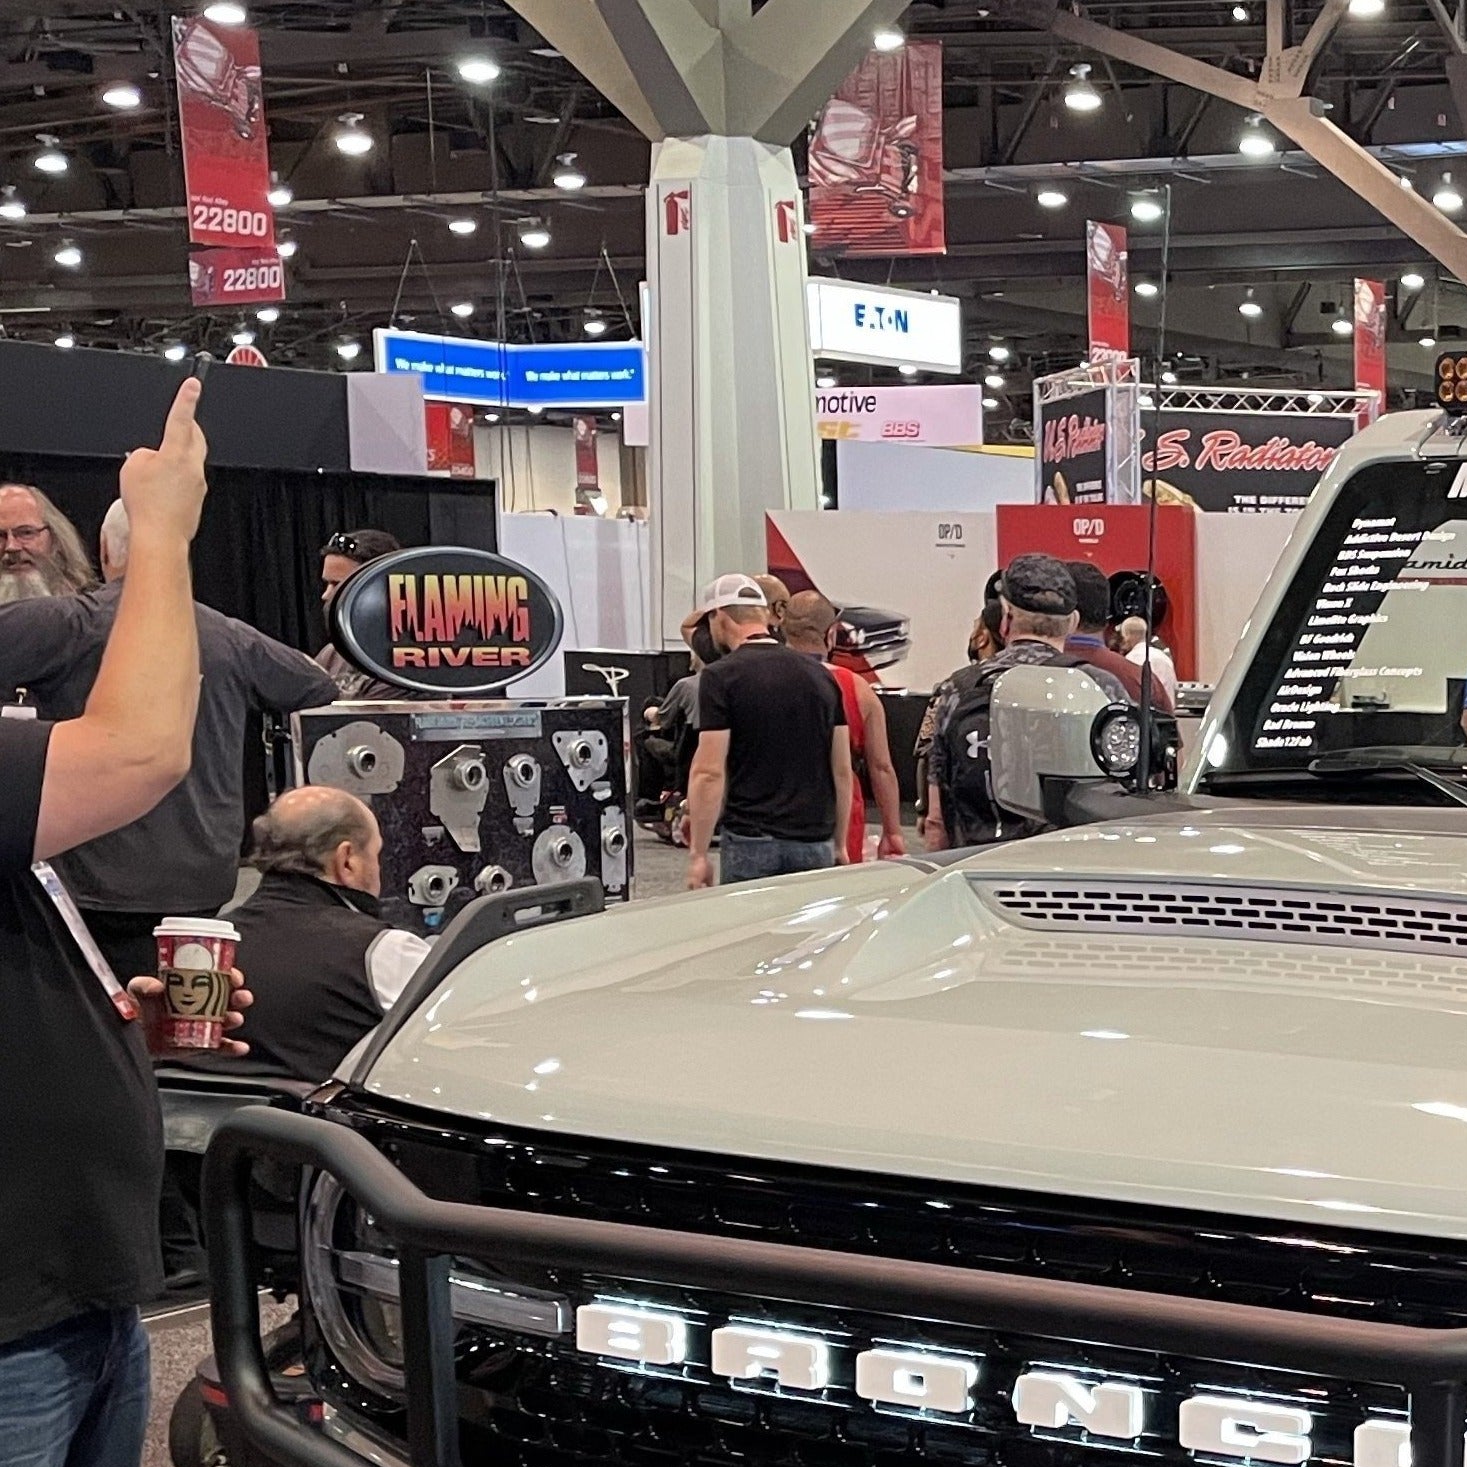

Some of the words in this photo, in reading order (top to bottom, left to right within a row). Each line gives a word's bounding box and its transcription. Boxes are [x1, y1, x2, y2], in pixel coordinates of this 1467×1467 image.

[193, 205, 267, 237] 22800
[223, 266, 281, 292] 22800
[881, 420, 920, 438] BBS
[388, 574, 530, 642] FLAMING
[392, 646, 531, 668] RIVER
